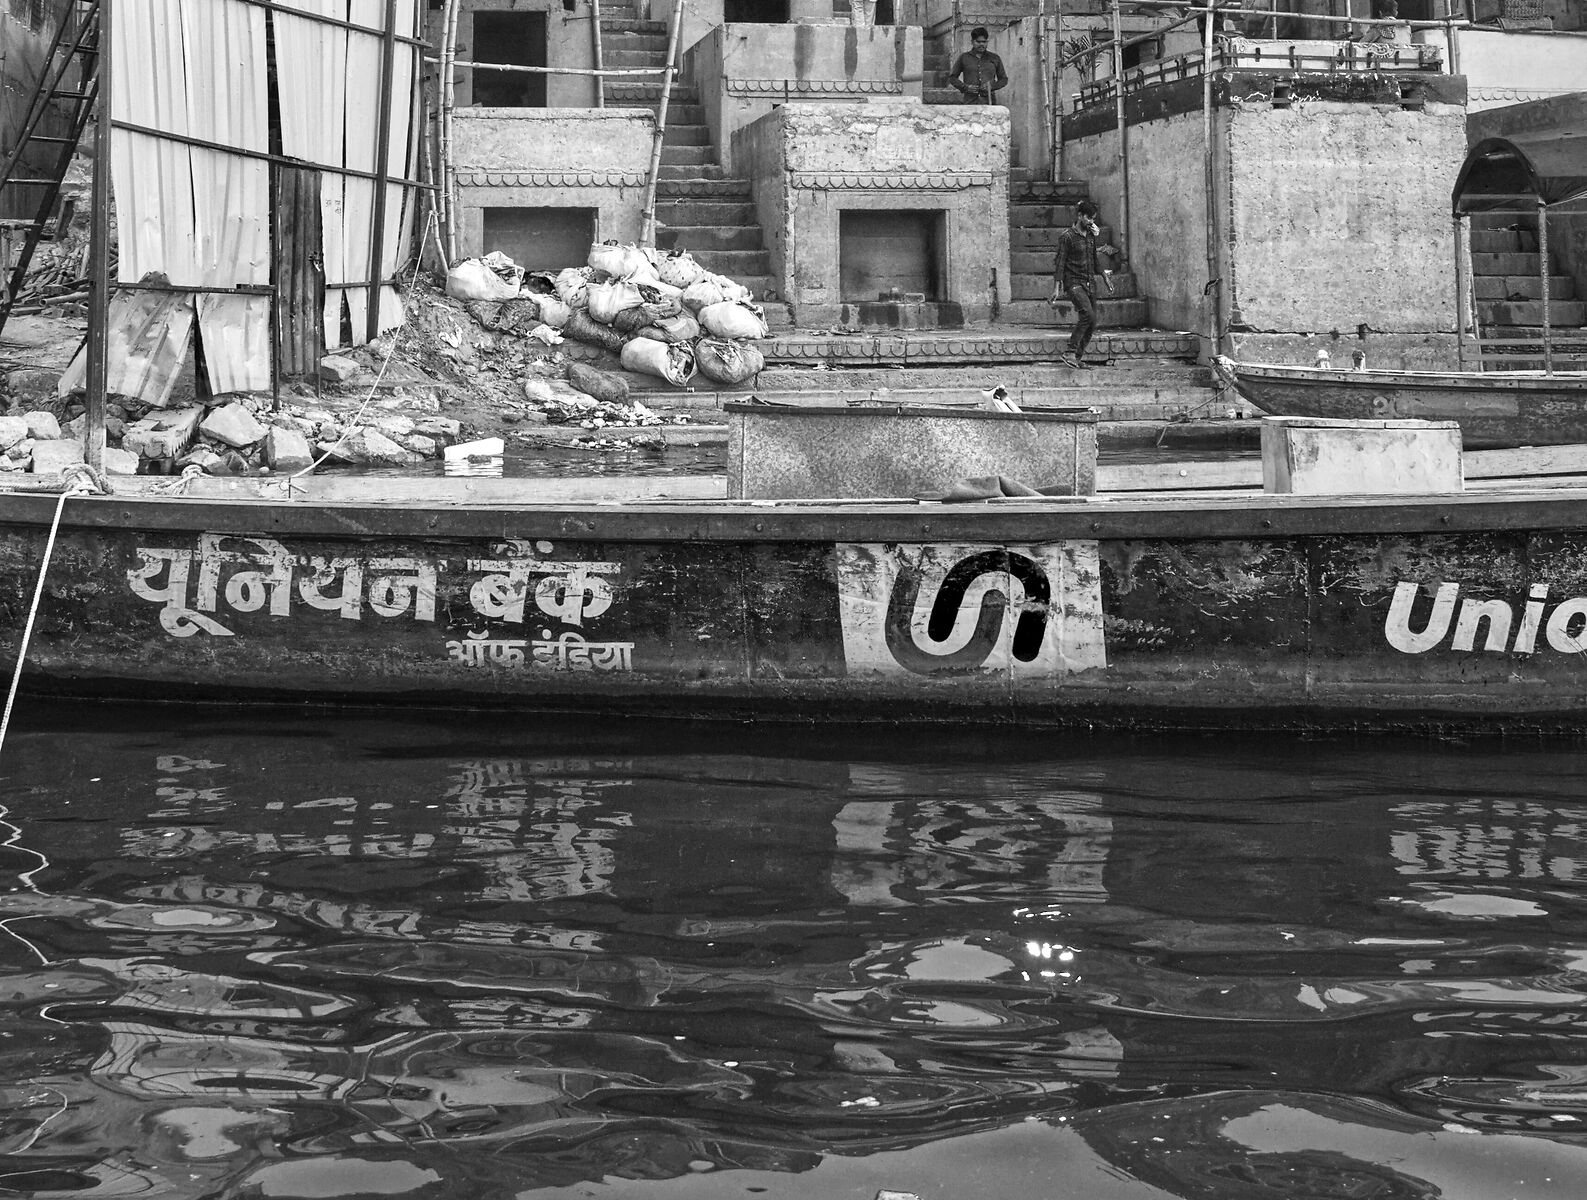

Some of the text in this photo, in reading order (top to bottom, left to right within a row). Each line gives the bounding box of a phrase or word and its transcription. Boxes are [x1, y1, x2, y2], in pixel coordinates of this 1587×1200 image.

[127, 531, 621, 638] यूनियन बैंक
[446, 629, 635, 672] ऑफ इंडिया
